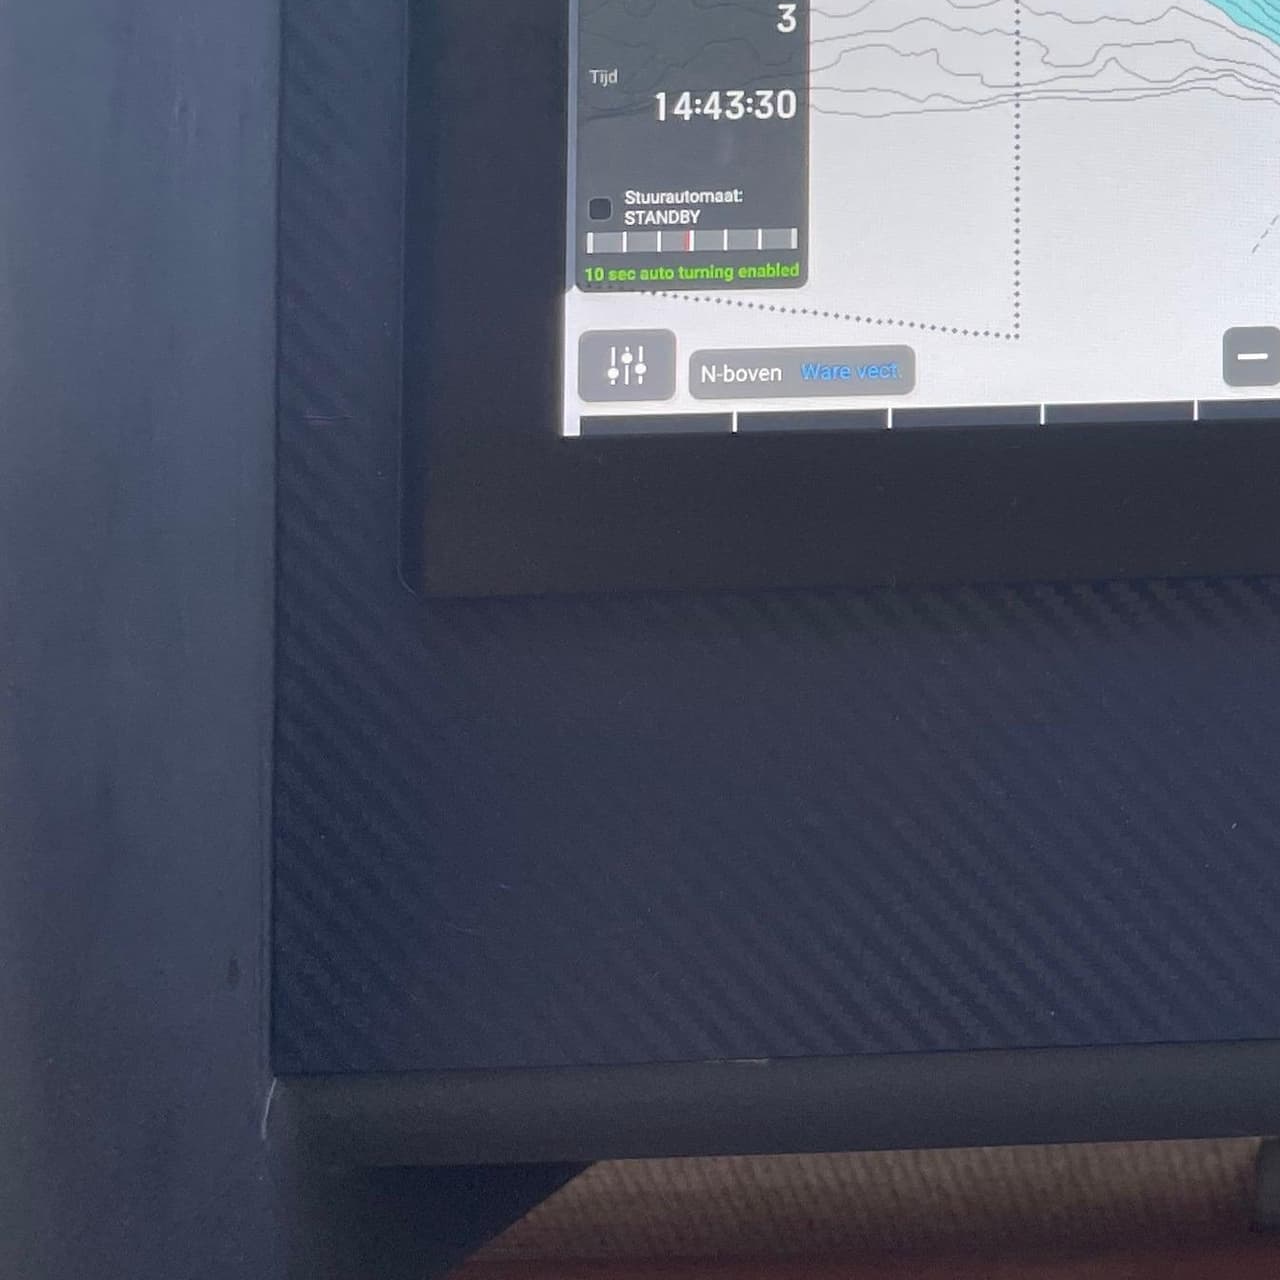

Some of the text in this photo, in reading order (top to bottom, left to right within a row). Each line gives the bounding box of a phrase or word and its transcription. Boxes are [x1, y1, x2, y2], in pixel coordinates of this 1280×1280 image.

[776, 3, 797, 33] 3
[589, 69, 618, 87] Tijd
[655, 89, 797, 122] 14:43:30
[624, 188, 745, 206] Stuurautomaat:
[624, 209, 701, 226] STANDBY
[585, 262, 800, 282] 10 sec auto turning enabled
[701, 363, 783, 383] N-boven
